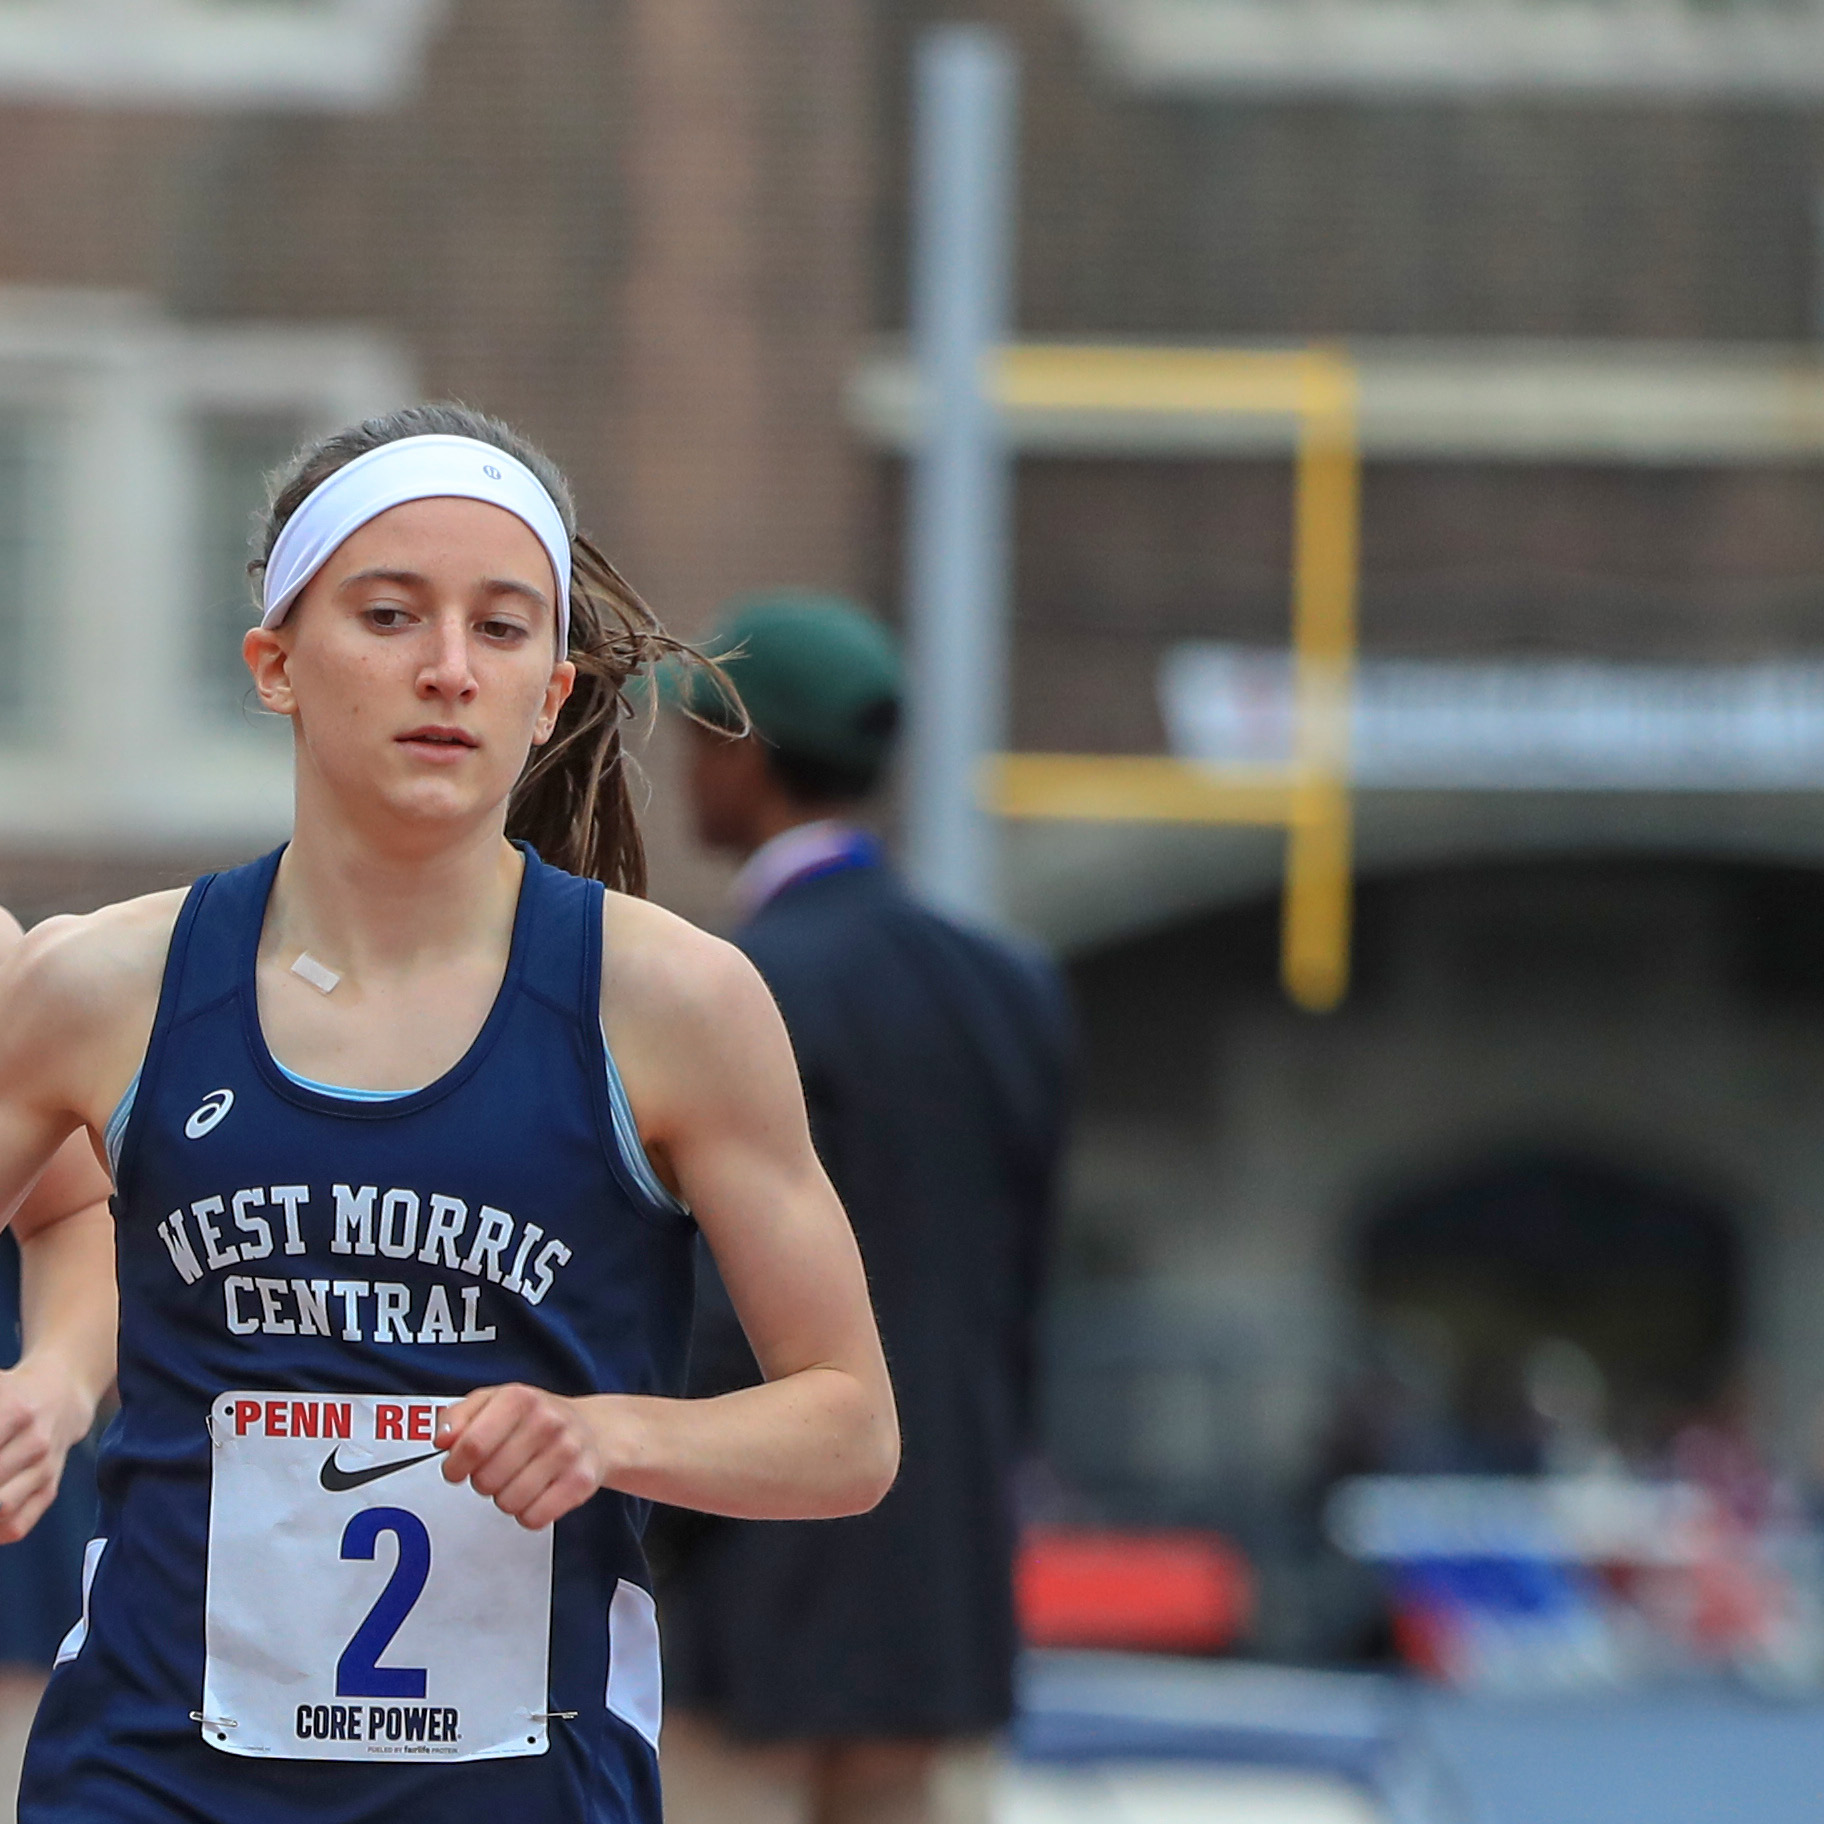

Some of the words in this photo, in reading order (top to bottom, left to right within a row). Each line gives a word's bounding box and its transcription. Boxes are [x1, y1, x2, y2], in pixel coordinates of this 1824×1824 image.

[156, 1184, 310, 1286] WEST
[330, 1183, 573, 1306] MORRIS
[223, 1275, 497, 1344] CENTRAL
[235, 1400, 353, 1440] PENN
[334, 1506, 431, 1699] 2
[296, 1704, 363, 1741] CORE
[368, 1706, 459, 1743] POWER
